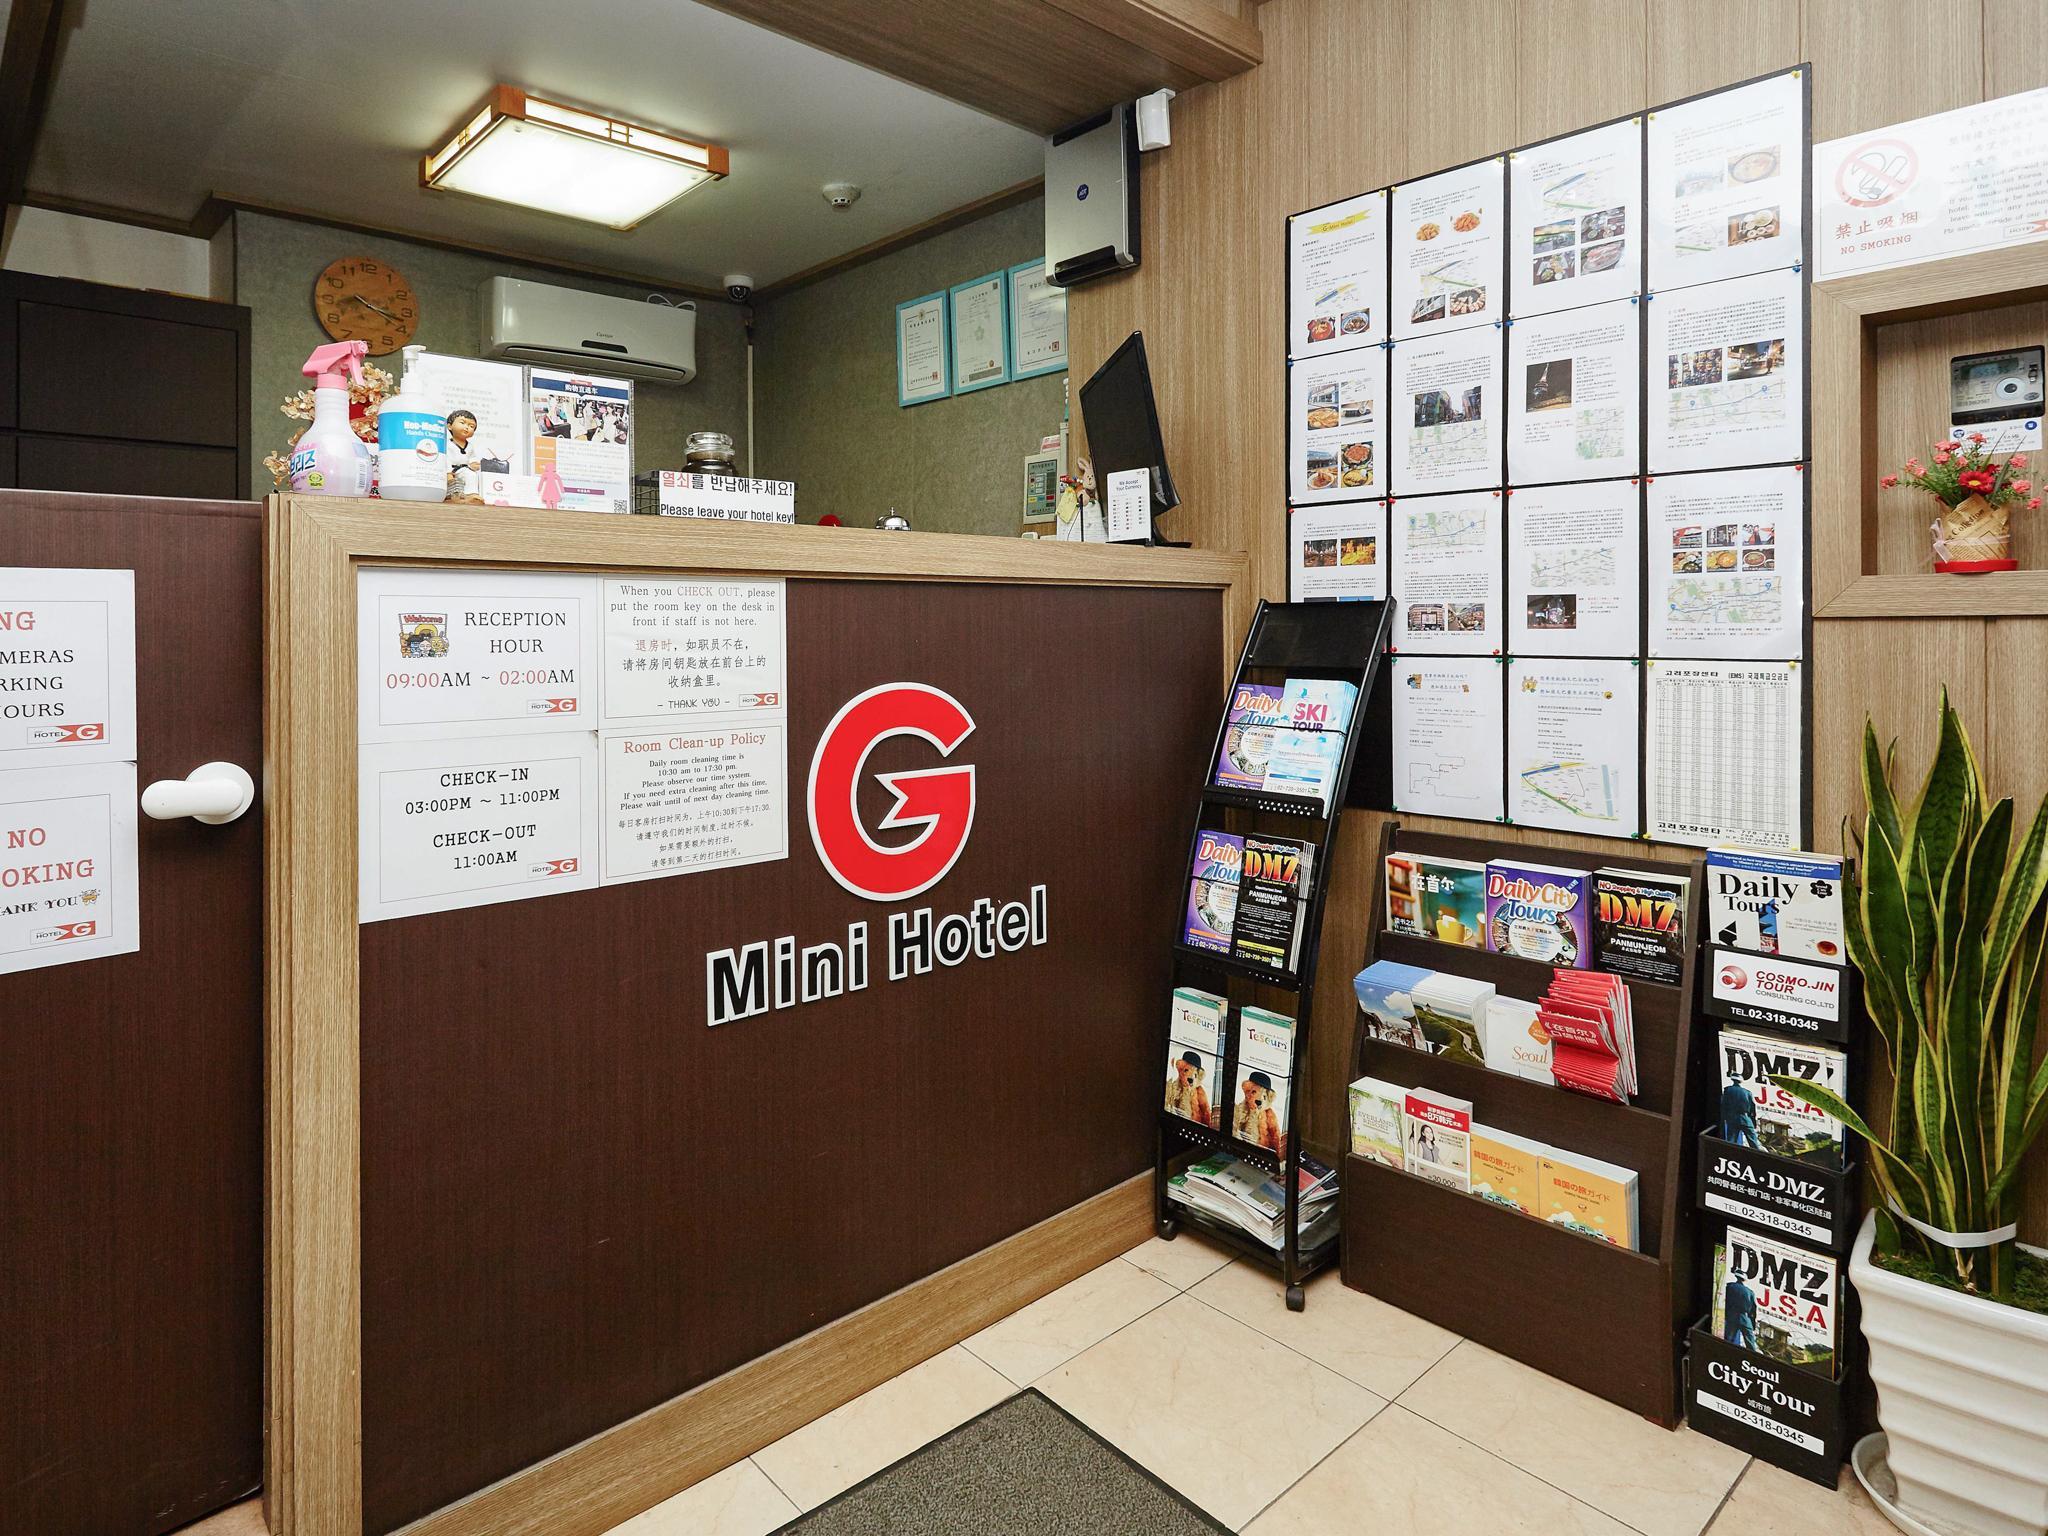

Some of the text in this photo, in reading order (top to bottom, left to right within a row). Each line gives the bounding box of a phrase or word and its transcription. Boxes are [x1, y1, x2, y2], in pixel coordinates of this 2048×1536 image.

[1840, 234, 1912, 255] NO SMOKING
[341, 266, 354, 276] 11
[360, 263, 377, 274] 12
[326, 277, 344, 288] 10
[386, 273, 392, 283] 1
[396, 290, 407, 300] 2
[328, 314, 339, 323] 8
[401, 308, 412, 318] 3
[341, 329, 352, 338] 7
[395, 325, 406, 334] 4
[383, 336, 393, 345] 5
[663, 471, 792, 496] 열쇠를 반납해주세요!
[661, 504, 794, 523] Please leave your hotel key!
[620, 585, 775, 597] When you CHECK OUT, please
[610, 603, 626, 612] put
[633, 602, 648, 611] the
[654, 603, 679, 611] room
[684, 602, 701, 612] key
[722, 602, 737, 611] the
[741, 602, 762, 611] desk
[766, 603, 775, 611] in
[403, 615, 443, 624] Welcome
[464, 612, 567, 627] RECEPTION
[632, 616, 757, 626] front if staff is not here.
[490, 639, 545, 653] HOUR
[0, 649, 74, 664] MERAS
[623, 655, 766, 671] 请将房间钥匙放在前台上的
[386, 669, 575, 689] 09:00AM 02:00AM
[668, 674, 721, 689] 收纳盒里。
[558, 699, 574, 711] G
[668, 698, 720, 709] THANK YOU
[764, 694, 776, 705] G
[1233, 691, 1276, 713] Daily
[0, 702, 65, 719] OURS
[1294, 703, 1328, 721] SKI
[76, 724, 99, 740] G
[1292, 722, 1323, 733] TOUR
[624, 732, 766, 753] Room Clean-up Policy
[649, 759, 667, 768] Daily
[691, 755, 719, 764] cleaning
[440, 768, 529, 787] CHECK-IN
[658, 769, 678, 777] 10:30
[704, 764, 722, 772] 17:30
[728, 772, 751, 780] system.
[632, 793, 646, 801] you
[649, 789, 665, 797] need
[668, 788, 686, 796] extra
[689, 784, 717, 793] cleaning
[806, 681, 977, 902] G
[405, 789, 560, 815] 03:00PM 11:00PM
[620, 803, 643, 811] Please
[725, 791, 752, 799] cleaning
[7, 827, 46, 849] NO
[433, 824, 537, 848] CHECK-OUT
[454, 850, 518, 870] 11:00AM
[1199, 840, 1242, 865] Daily
[1, 859, 94, 887] OKING
[559, 860, 574, 872] G
[1244, 850, 1299, 884] DMZ
[1413, 872, 1456, 896] 在首尔
[1488, 874, 1578, 909] Daily City
[1599, 880, 1611, 890] NO
[1717, 873, 1799, 905] Daily
[0, 896, 78, 916] ANK YOU
[1508, 899, 1557, 923] Tours
[1599, 892, 1678, 933] DMZ
[1723, 896, 1780, 914] Tours
[36, 923, 92, 939] HOTEL G
[1611, 938, 1666, 953] PANMUNJEOM
[706, 884, 1047, 1027] Mini Hotel
[1755, 970, 1835, 993] COSMO.JIN
[1756, 980, 1794, 994] TOUR
[1755, 990, 1803, 1004] CONSULTING
[1181, 1007, 1216, 1031] Teseum
[1247, 1027, 1288, 1051] Teseum
[1512, 1046, 1549, 1064] Seoul
[1725, 1047, 1822, 1086] DMZ
[1731, 1240, 1829, 1307] DMZ
[1756, 1289, 1827, 1329] J.S.A
[1741, 1360, 1780, 1383] Seoul
[1708, 1361, 1816, 1417] City Tour
